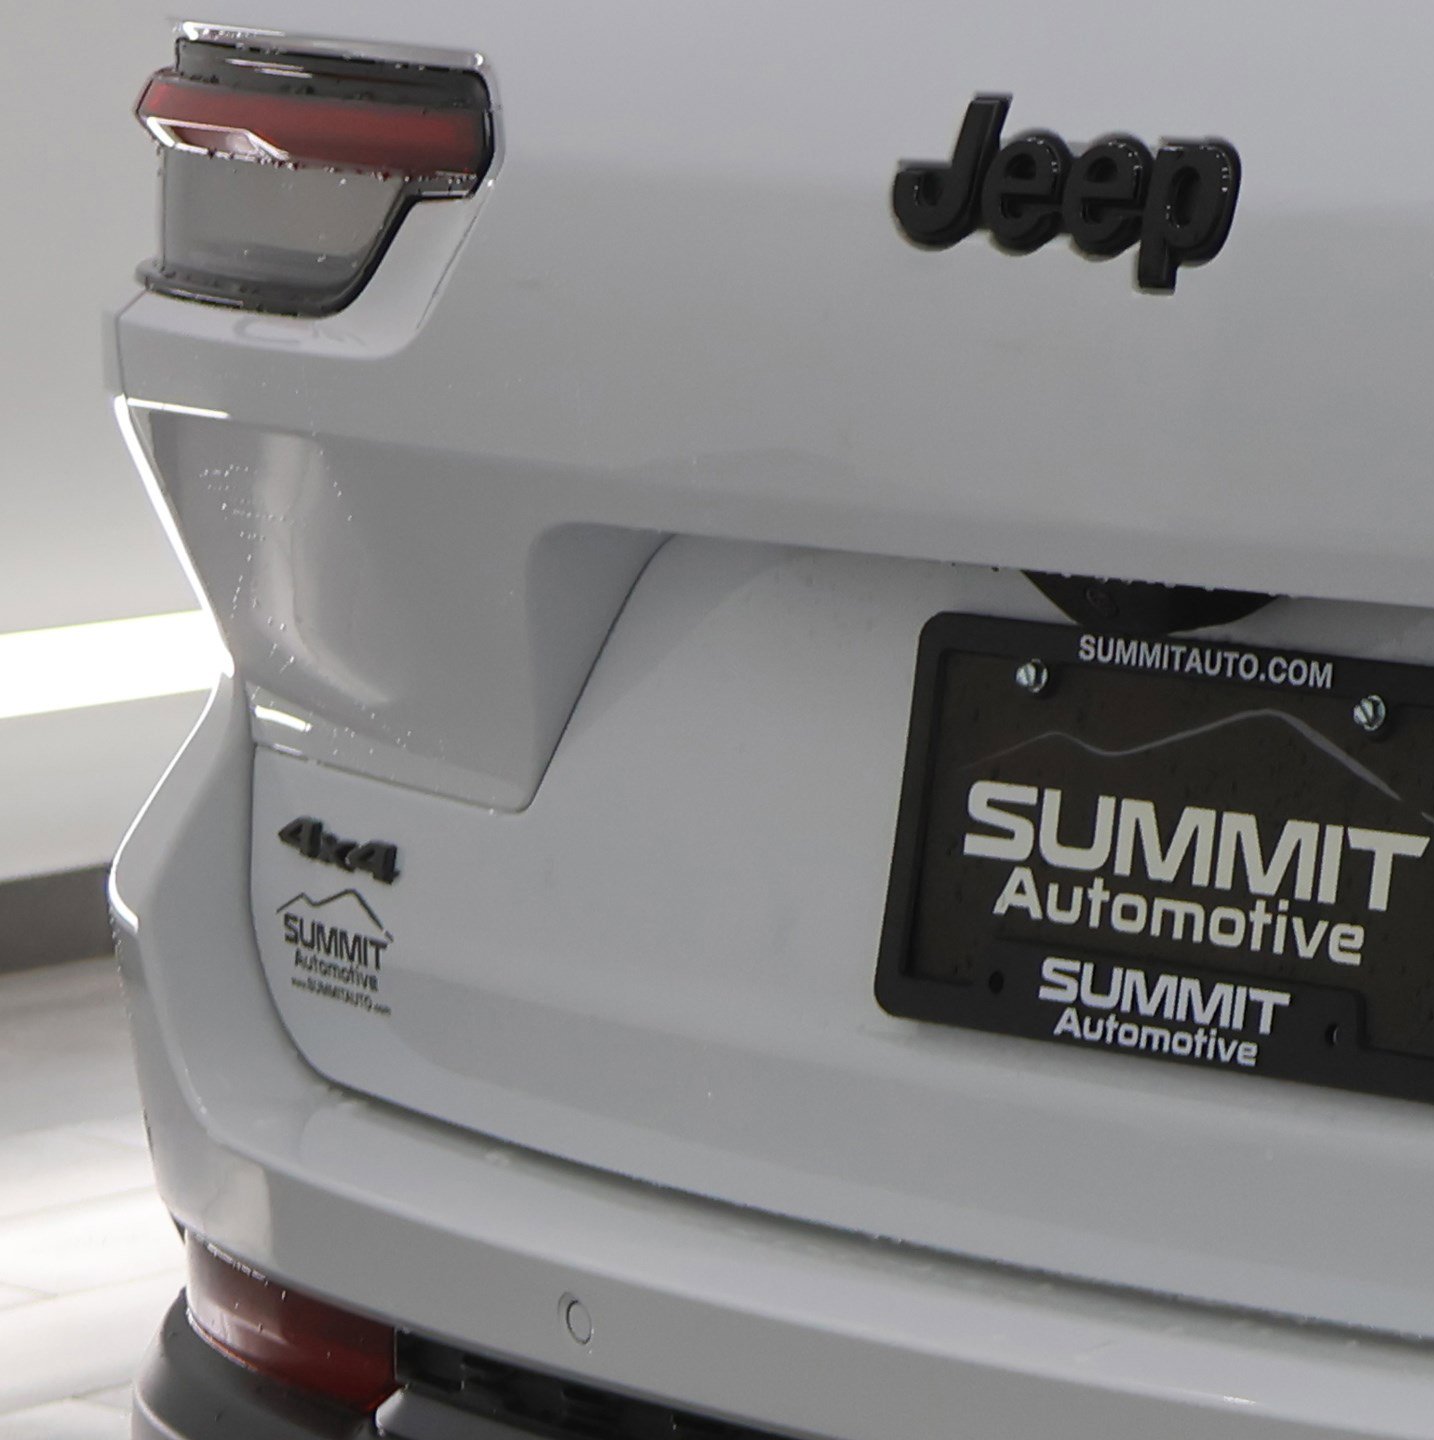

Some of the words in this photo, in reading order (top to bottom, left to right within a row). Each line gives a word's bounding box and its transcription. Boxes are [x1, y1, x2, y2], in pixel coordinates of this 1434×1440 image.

[893, 92, 1241, 293] Jeep
[1078, 633, 1334, 690] SUMMITAUTO.COM
[278, 815, 400, 885] 4x4
[963, 780, 1431, 912] SUMMIT
[284, 912, 389, 971] SUMMIT
[993, 868, 1366, 966] Automotive
[1038, 957, 1291, 1035] SUMMIT
[1053, 1007, 1260, 1067] Automotive
